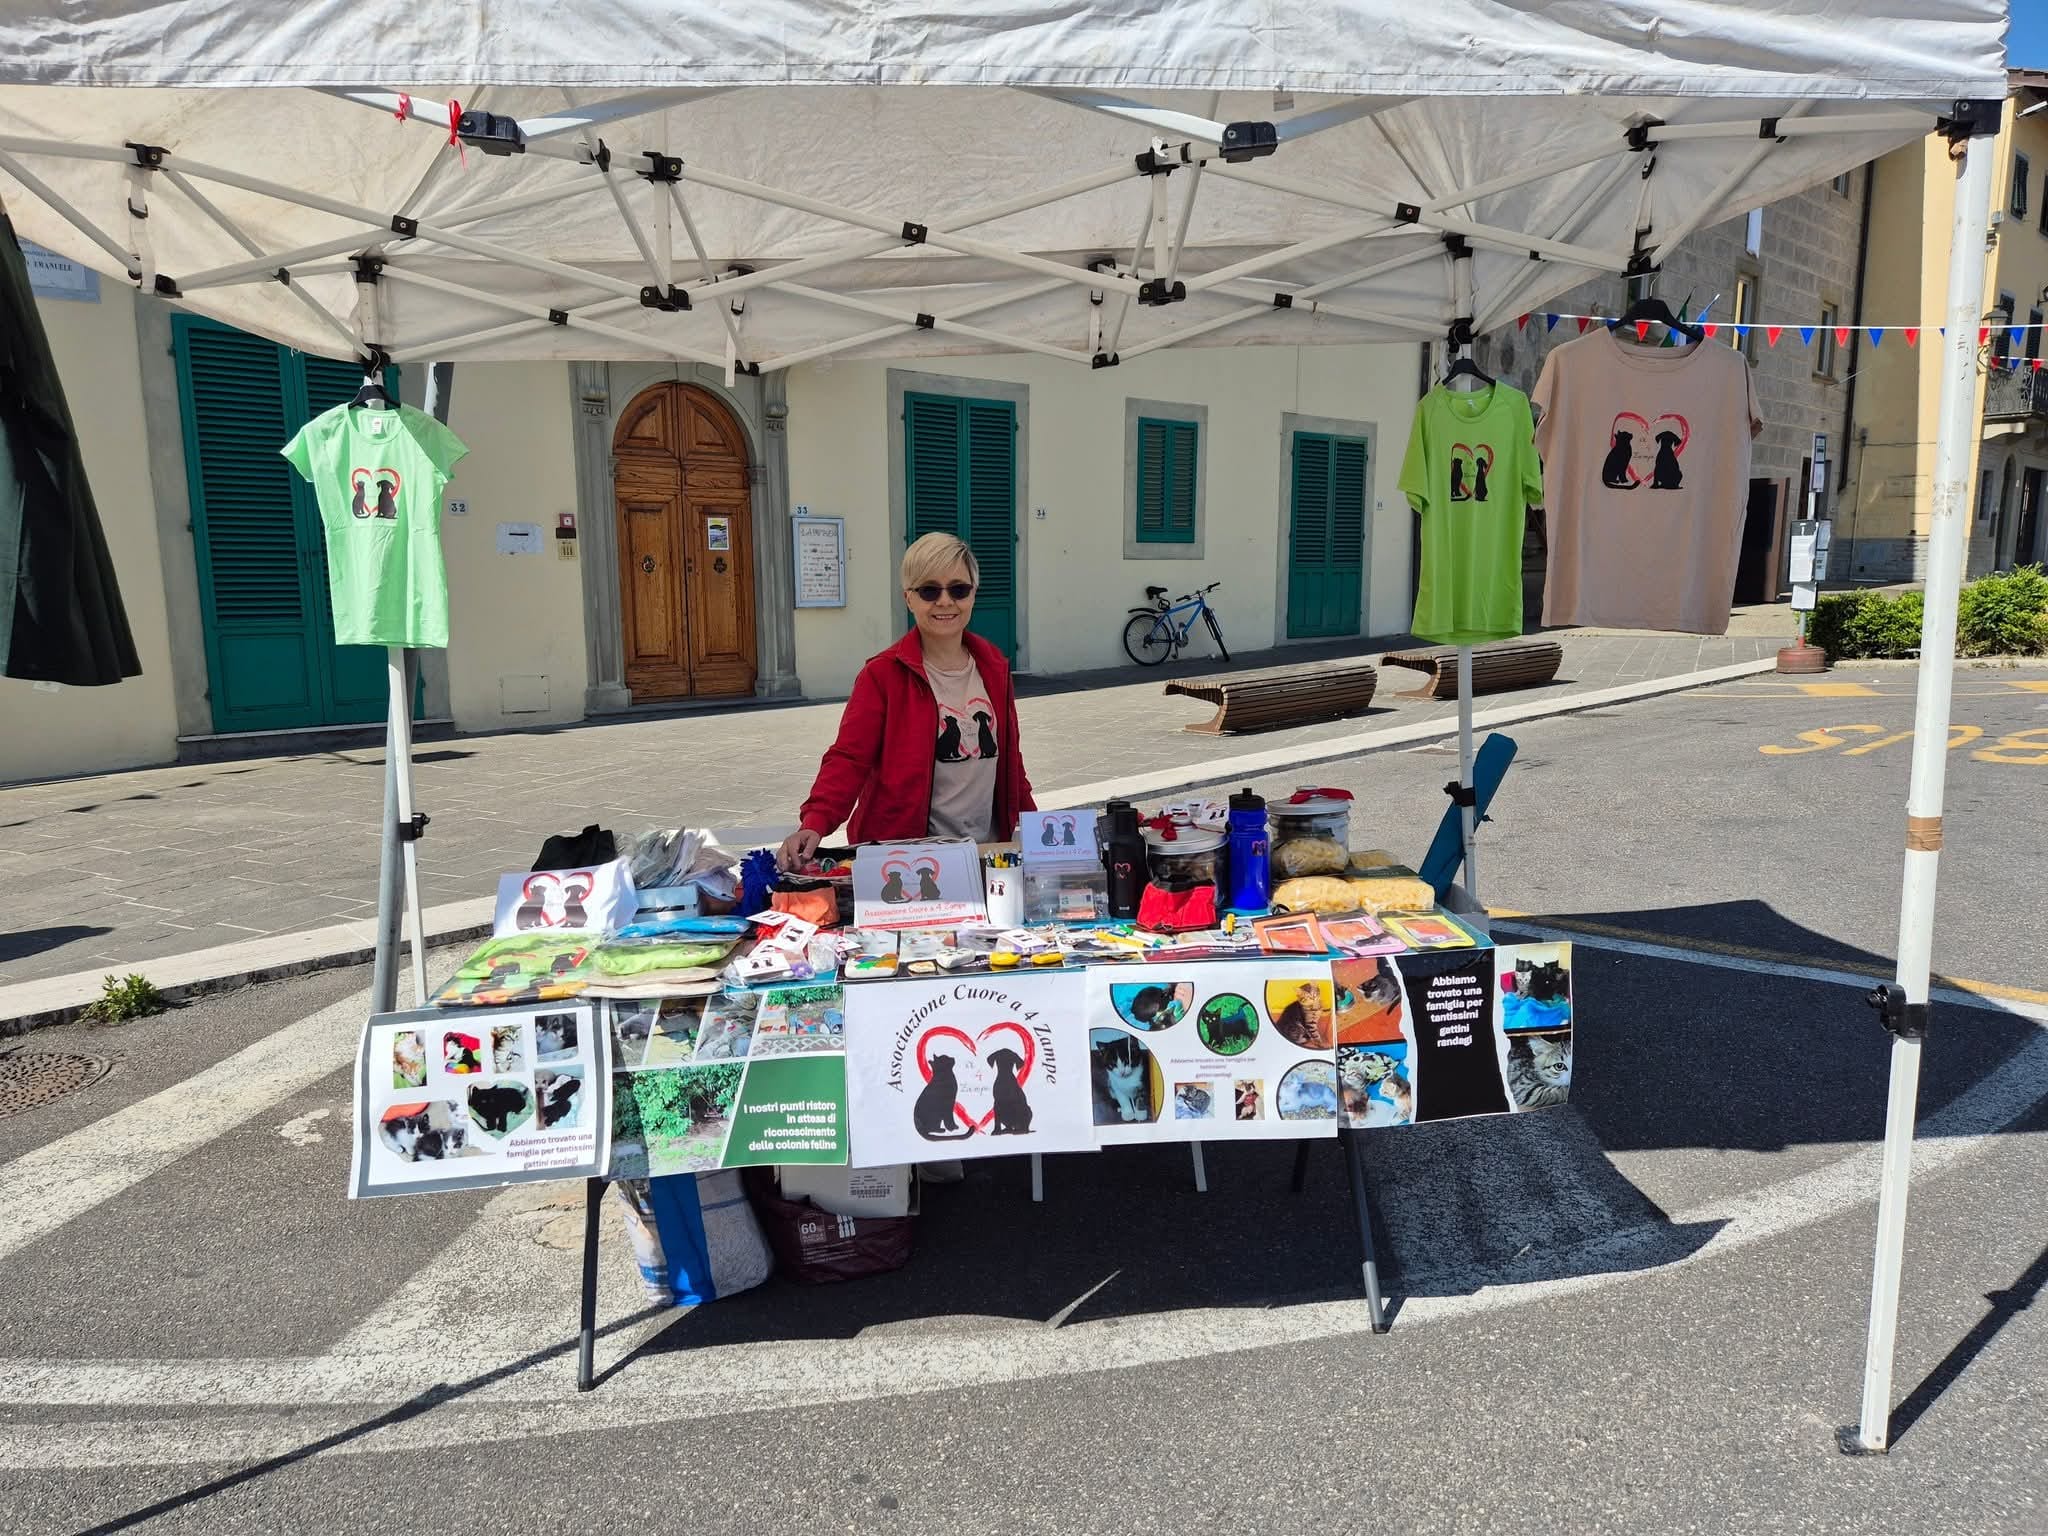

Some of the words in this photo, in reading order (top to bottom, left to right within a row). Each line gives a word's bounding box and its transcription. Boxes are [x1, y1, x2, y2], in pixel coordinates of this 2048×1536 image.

[451, 503, 466, 512] 32
[1432, 976, 1477, 987] Abbiamo
[1427, 988, 1462, 999] trovato
[1463, 987, 1482, 996] una
[1426, 1000, 1465, 1011] famiglia
[1466, 999, 1484, 1010] per
[1430, 1010, 1479, 1022] tantissimi
[1440, 1023, 1470, 1037] gattini
[887, 993, 946, 1093] Associazione
[953, 984, 1008, 1004] Cuore
[1010, 1001, 1023, 1012] a
[1024, 1009, 1040, 1021] 4
[1033, 1023, 1057, 1085] Zampe
[1437, 1035, 1473, 1047] randagi
[743, 1104, 748, 1114] I
[749, 1102, 778, 1113] nostri
[779, 1100, 805, 1113] punti
[806, 1100, 836, 1111] ristoro
[797, 1113, 826, 1123] attesa
[827, 1113, 836, 1123] di
[764, 1126, 836, 1137] riconoscimento
[509, 1137, 547, 1147] Abbiamo
[547, 1135, 577, 1144] trovato
[578, 1133, 593, 1141] una
[748, 1140, 774, 1151] delle
[775, 1139, 810, 1150] colonie
[810, 1139, 837, 1150] feline
[506, 1149, 540, 1158] famiglia
[541, 1148, 555, 1156] per
[556, 1144, 595, 1153] tantissimi
[801, 1222, 817, 1235] 60
